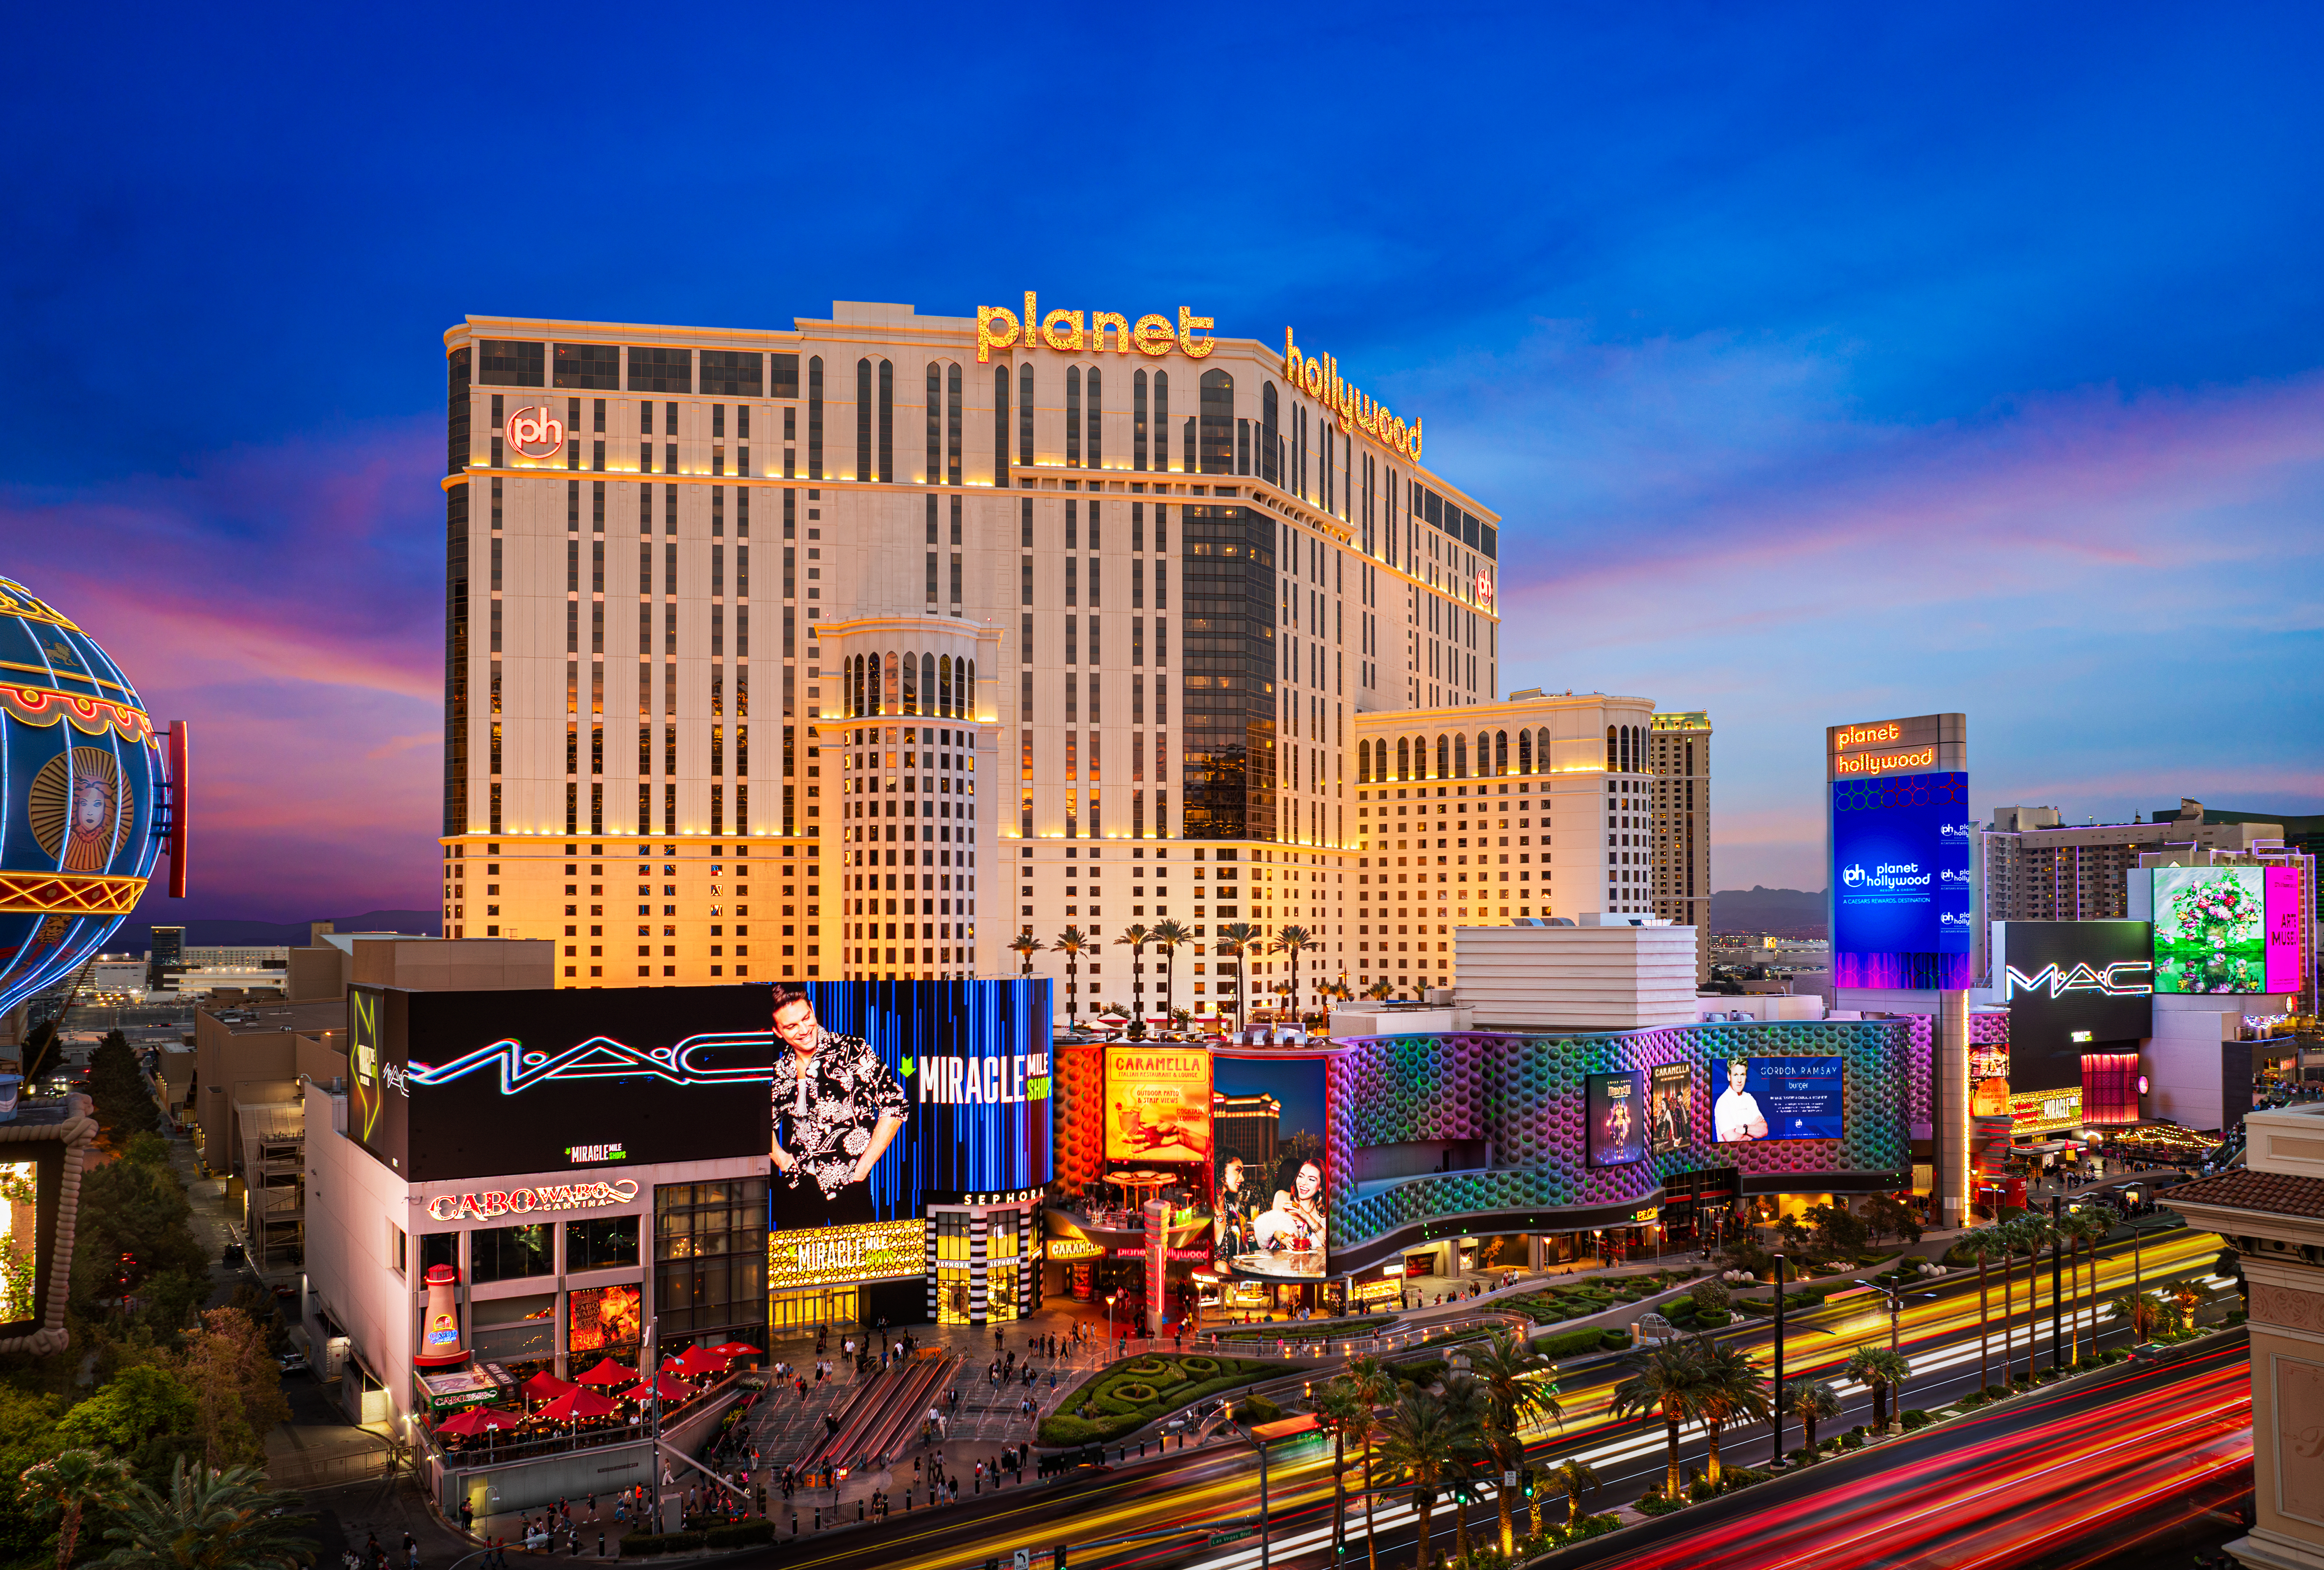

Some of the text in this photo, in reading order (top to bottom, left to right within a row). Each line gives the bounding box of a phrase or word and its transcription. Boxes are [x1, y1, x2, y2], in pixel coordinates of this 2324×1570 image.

[977, 291, 1215, 364] planet
[1286, 326, 1422, 462] hollywood
[513, 406, 563, 450] ph
[1838, 723, 1899, 751] planet
[1838, 748, 1933, 775] hollywood
[1942, 824, 1953, 835] ph
[1844, 863, 1865, 885] ph
[1877, 863, 1918, 877] planet
[1942, 869, 1953, 880] ph
[1867, 873, 1931, 889] hollywood
[1942, 912, 1953, 923] ph
[1027, 1052, 1048, 1076] MILE
[1116, 1057, 1200, 1071] CARAMELLA
[1655, 1064, 1690, 1077] CARAMELLA
[1761, 1067, 1796, 1075] GORDON
[919, 1055, 1025, 1105] MIRACLE
[1788, 1082, 1809, 1090] burger
[1027, 1076, 1052, 1101] SHOPS
[2044, 1098, 2070, 1120] MIRACLE
[571, 1144, 609, 1163] MIRACLE
[609, 1143, 622, 1152] MILE
[609, 1150, 626, 1160] SHOPS
[427, 1181, 611, 1222] CABO WABO
[964, 1187, 1044, 1206] SEPHORA
[544, 1200, 606, 1211] CANTINA
[865, 1235, 889, 1251] MILE
[798, 1238, 865, 1272] MIRACLE
[865, 1250, 894, 1265] SHOPS
[1117, 1247, 1209, 1261] plane llywood
[989, 1257, 1020, 1268] SEPHORA
[573, 1301, 600, 1313] CABO
[574, 1308, 600, 1319] WABO
[575, 1316, 601, 1328] MEXICAN
[428, 1329, 458, 1340] CABO
[576, 1324, 595, 1335] FOOD
[434, 1394, 466, 1406] CABO
[1223, 1534, 1239, 1542] Vegas
[1240, 1529, 1251, 1538] Blvd
